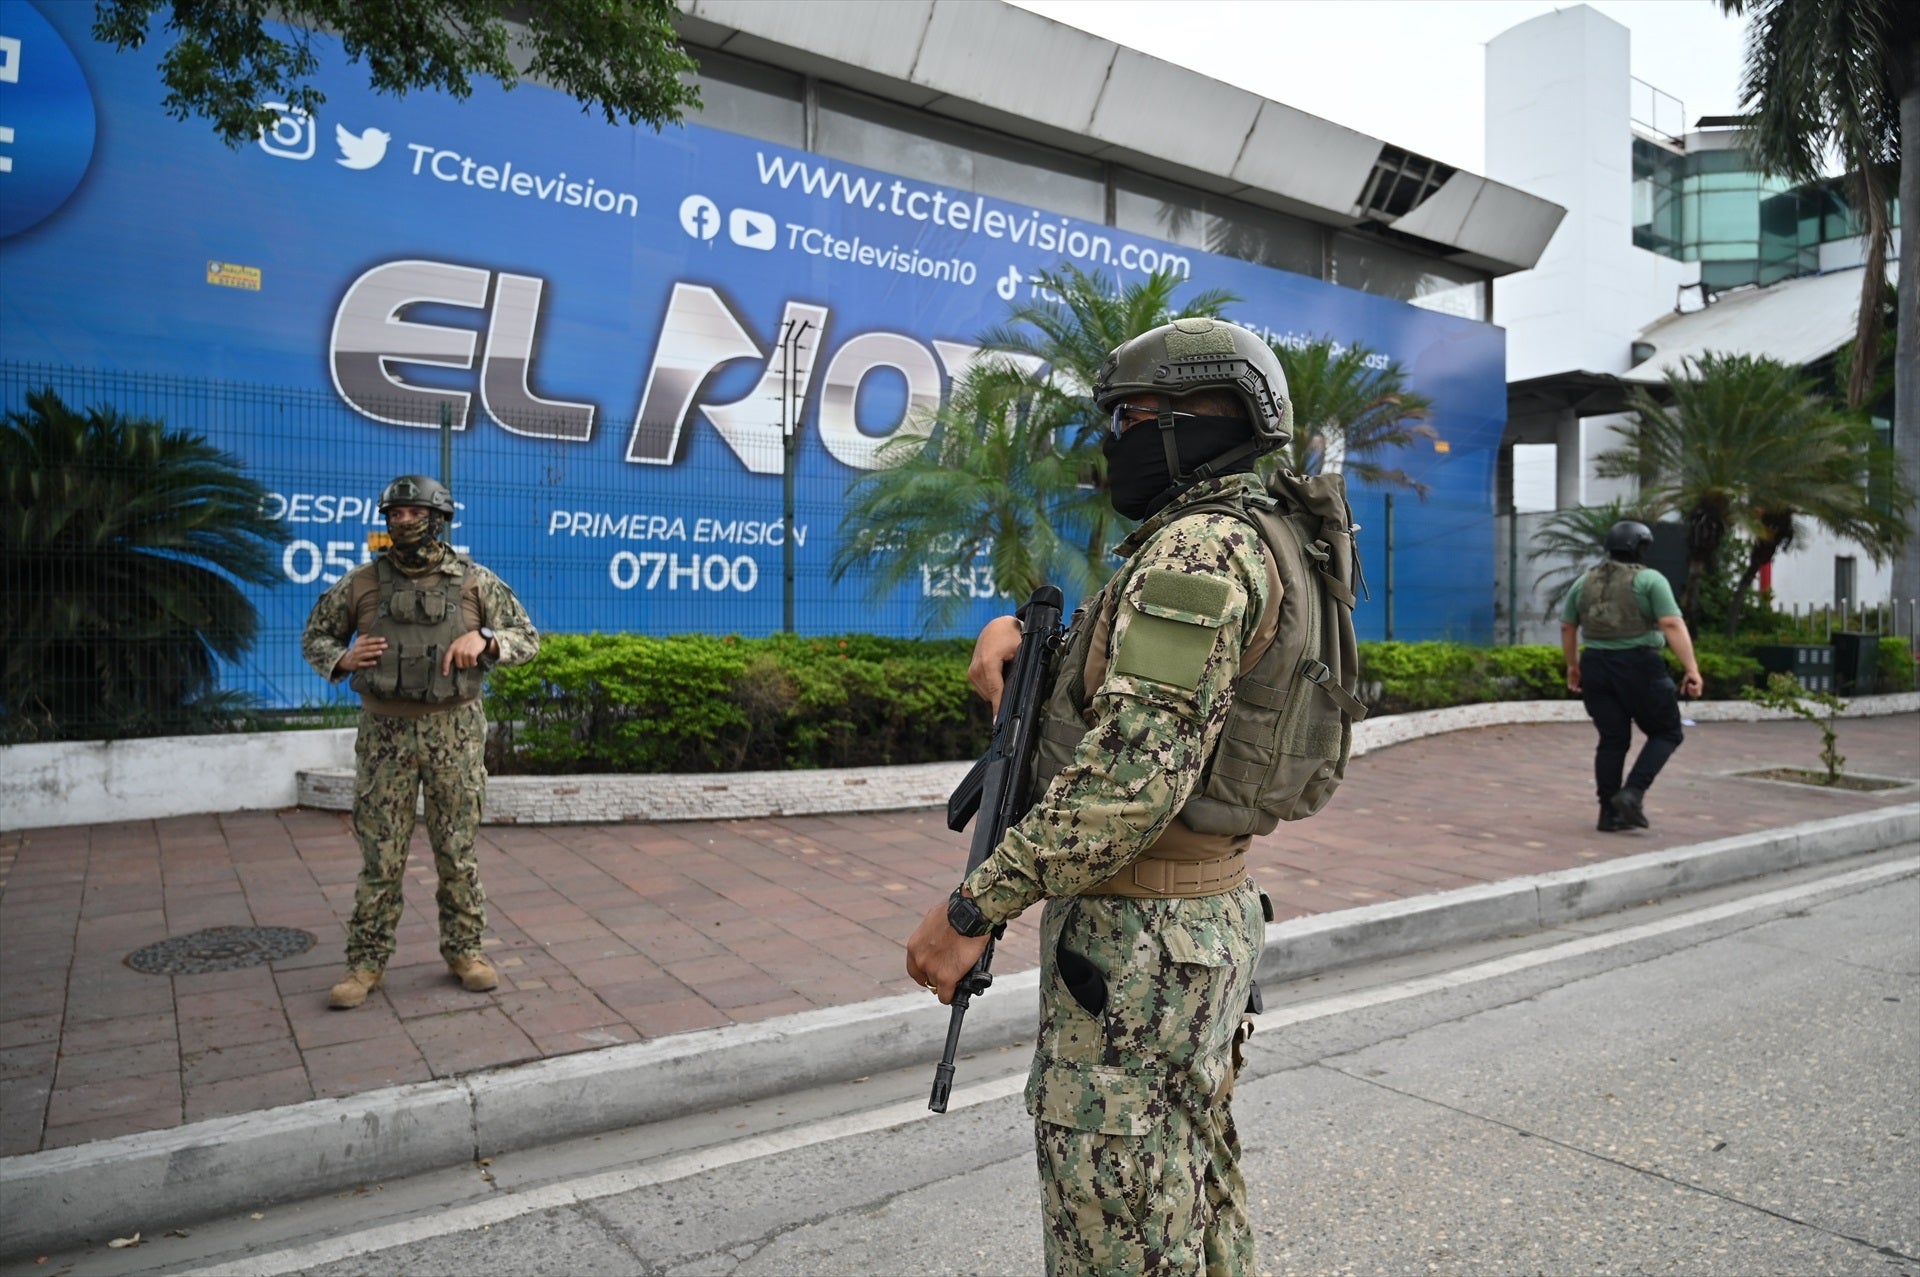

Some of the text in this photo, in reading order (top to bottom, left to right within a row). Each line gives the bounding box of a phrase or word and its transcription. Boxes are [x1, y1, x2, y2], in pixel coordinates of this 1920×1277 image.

[408, 143, 638, 217] TCtelevision
[757, 152, 1190, 282] www.tctelevision.com
[785, 223, 977, 286] TCtelevision10
[330, 260, 595, 442] EL
[548, 510, 807, 547] PRIMERA EMISIÓN
[609, 550, 759, 592] 07H00
[918, 563, 1010, 599] 12H3
